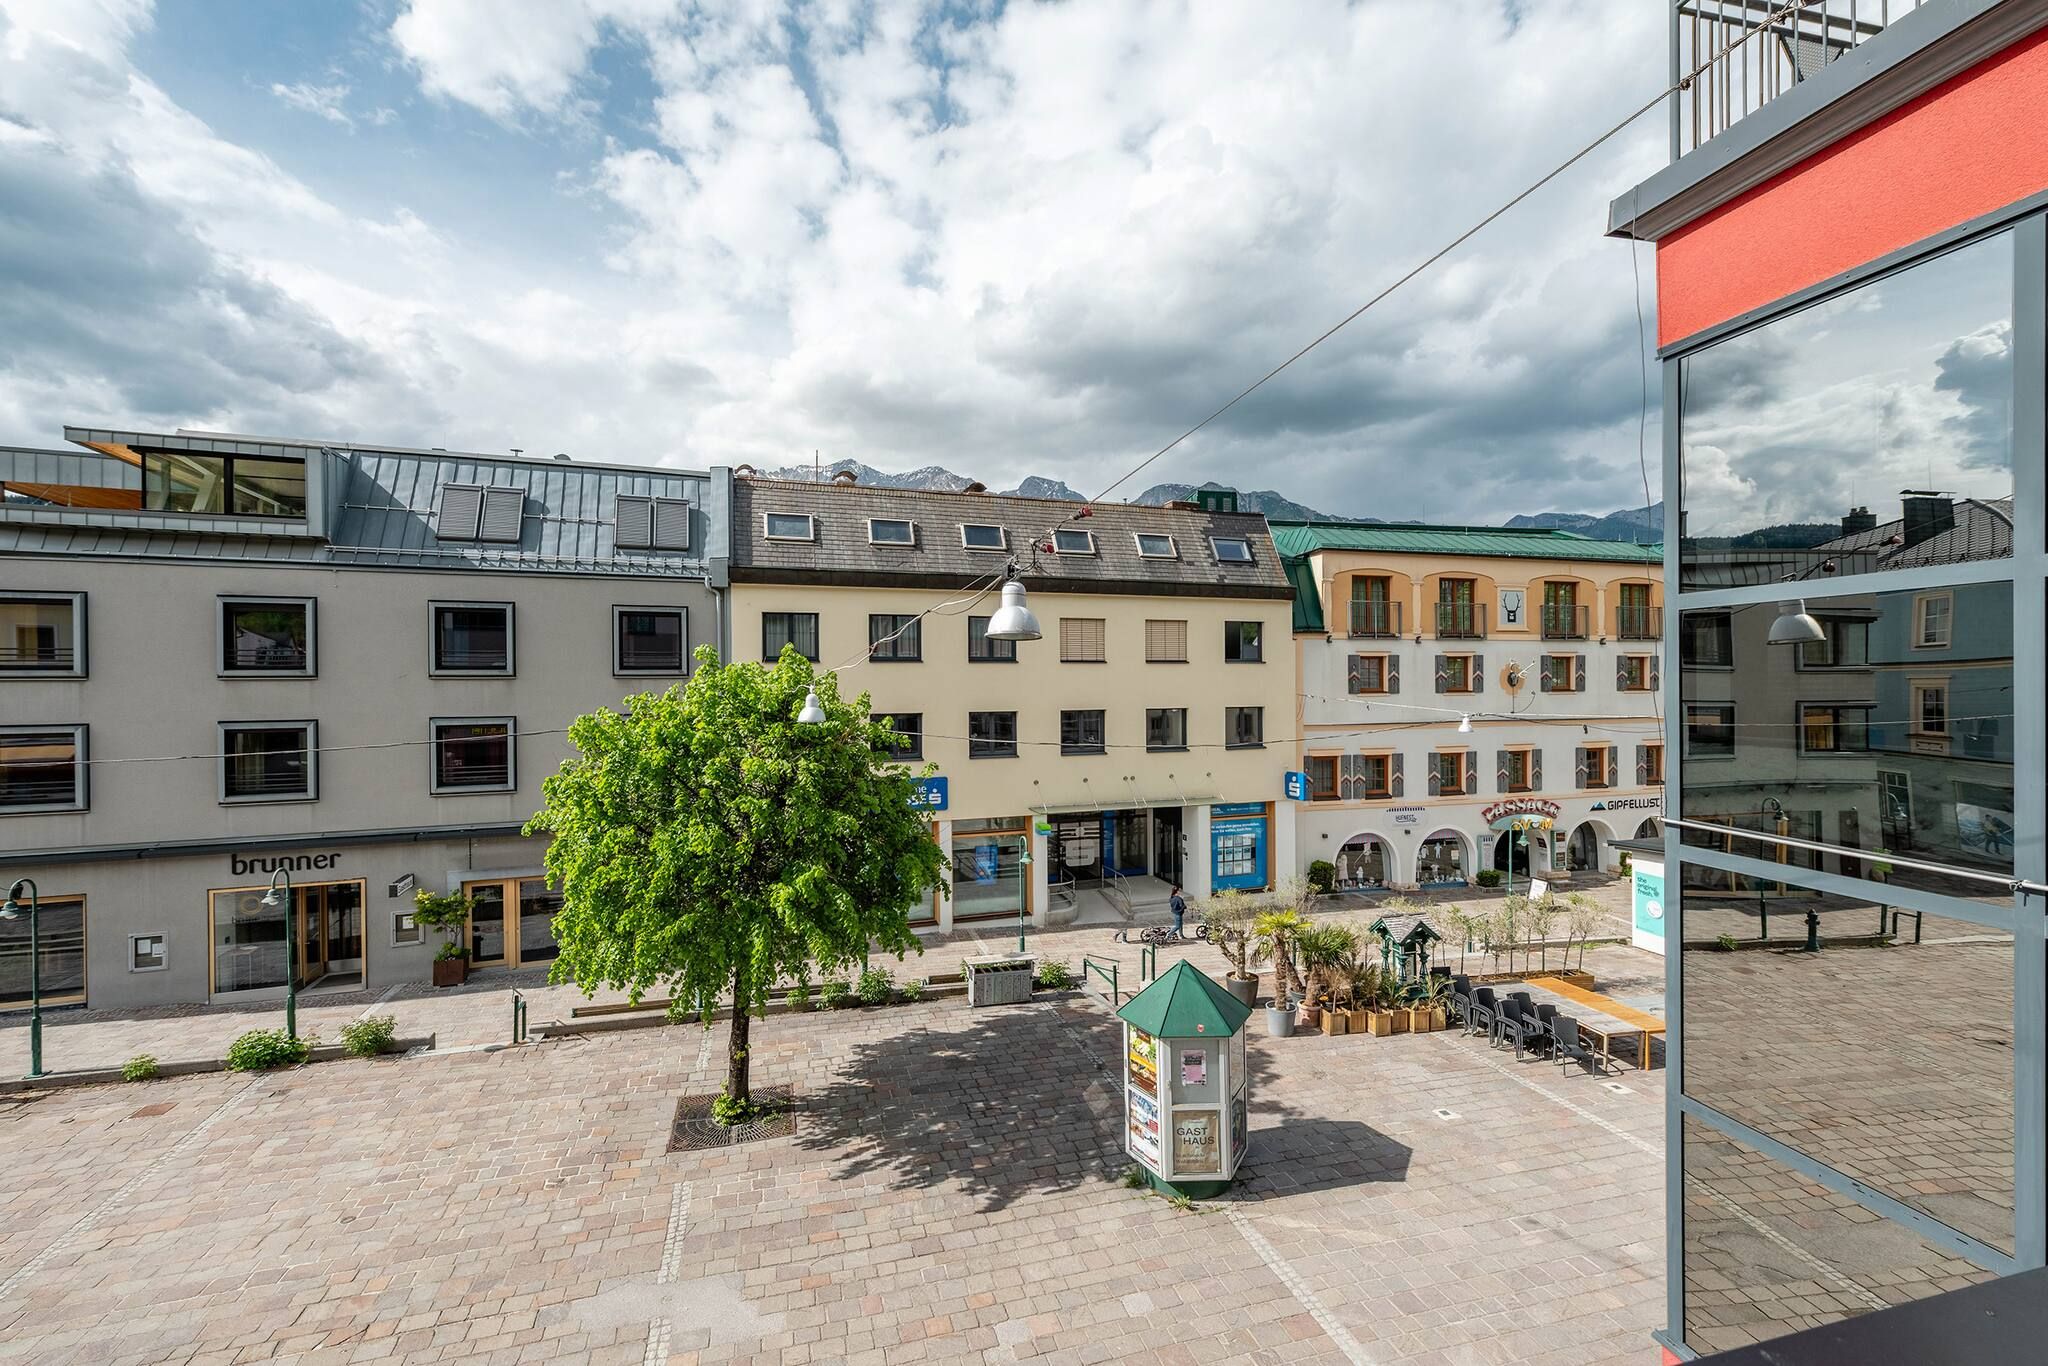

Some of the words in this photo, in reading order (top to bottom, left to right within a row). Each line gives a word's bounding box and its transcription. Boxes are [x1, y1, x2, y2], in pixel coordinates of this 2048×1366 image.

[1607, 797, 1660, 811] GIPFELLUST
[231, 853, 342, 875] brunner
[1176, 1127, 1208, 1136] GAST
[1183, 1136, 1215, 1145] HAUS
